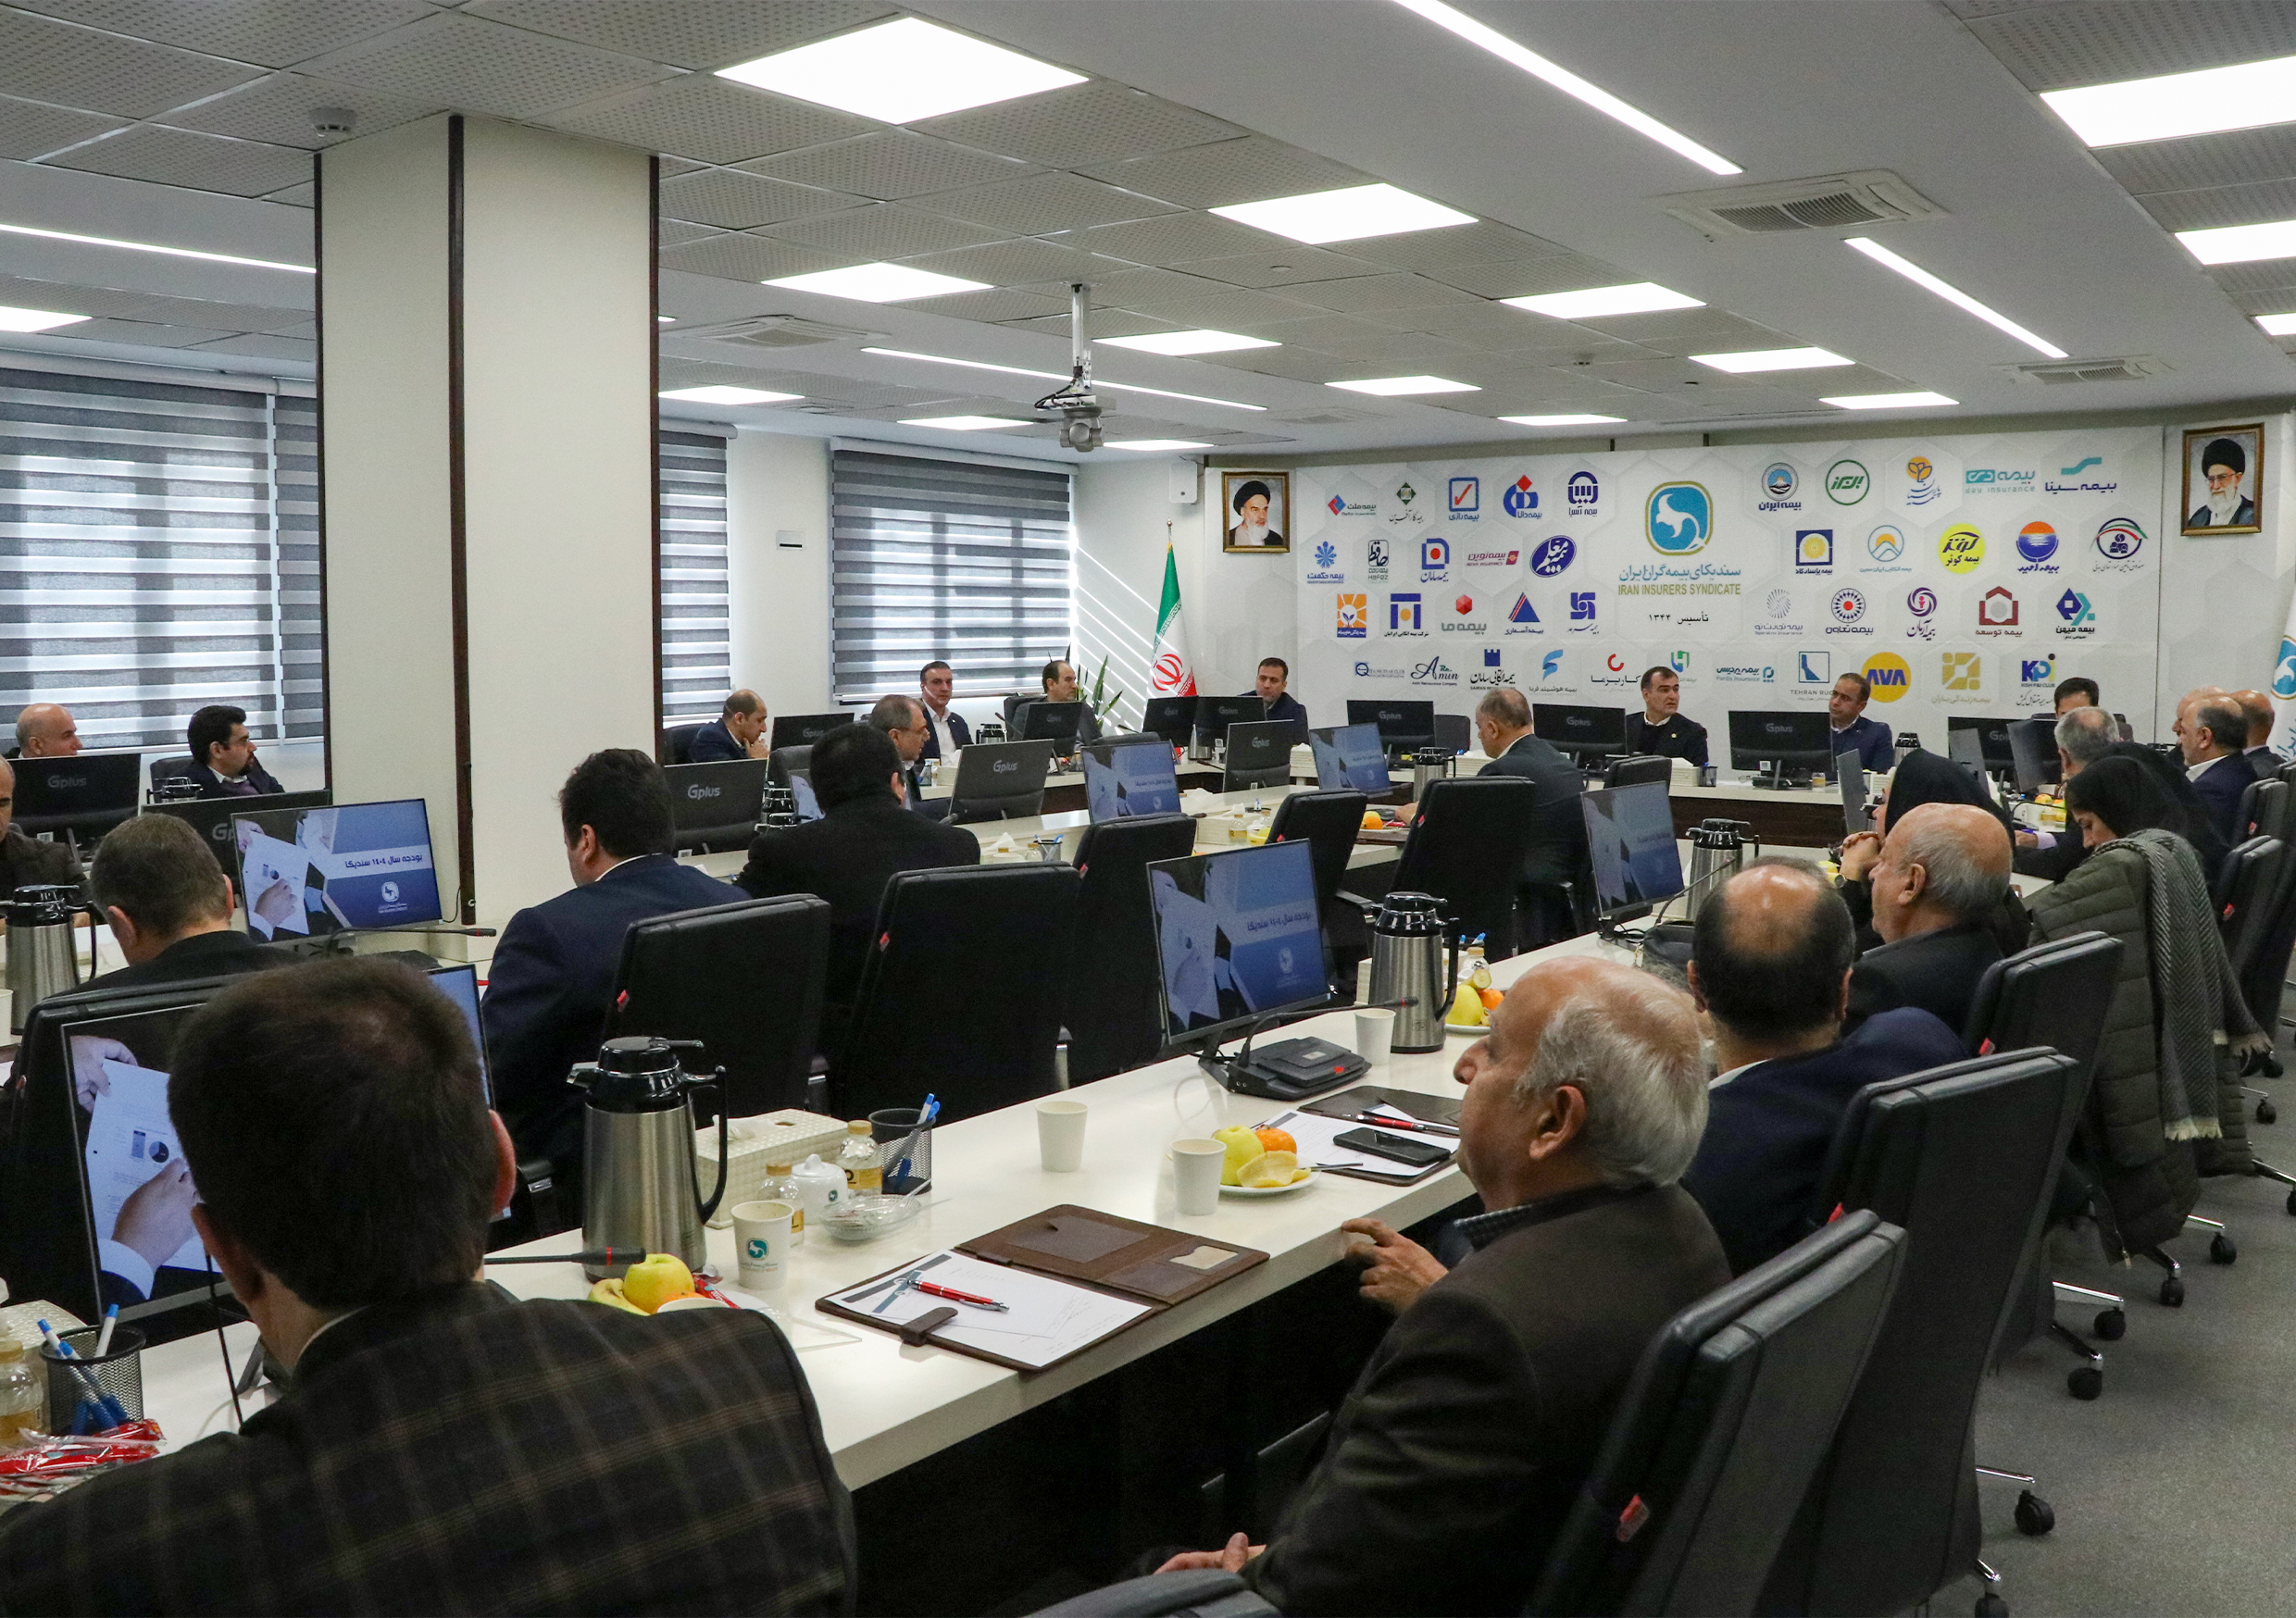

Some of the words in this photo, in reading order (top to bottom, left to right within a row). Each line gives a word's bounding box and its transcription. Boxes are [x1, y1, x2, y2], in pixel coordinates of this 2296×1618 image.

[1997, 470, 2036, 484] بیمه
[1987, 485, 2036, 493] insurance
[2045, 481, 2078, 495] سینا
[2080, 483, 2117, 493] بیمه
[1568, 505, 1583, 517] آسیا
[1758, 502, 1779, 512] ایران
[1780, 502, 1802, 511] بیمه
[1449, 512, 1464, 521] رازی
[1529, 512, 1542, 520] بیمه
[1584, 508, 1598, 517] بیمه
[1464, 514, 1479, 522] بیمه
[1467, 553, 1489, 562] نوین
[1488, 553, 1506, 561] بیمه
[1945, 554, 1963, 566] کوثر
[1965, 556, 1980, 565] بیمه
[1619, 565, 1646, 582] ایران
[1642, 563, 1666, 581] گران
[1665, 567, 1690, 581] بیمه
[1690, 563, 1741, 580] سندیکای
[1795, 567, 1821, 576] پاسارگاد
[1329, 573, 1344, 581] بیمه
[1420, 571, 1440, 583] سامان
[1618, 583, 1640, 595] IRAN
[1641, 583, 1687, 595] INSURERS
[1690, 583, 1741, 595] SYNDICATE
[1677, 611, 1709, 626] تأسیس
[1441, 622, 1455, 632] ما
[1456, 623, 1487, 636] بیمه
[1825, 624, 1851, 635] تعاون
[1851, 627, 1874, 636] بیمه
[1906, 618, 1933, 638] آرمان
[2055, 626, 2077, 635] میهن
[2078, 627, 2095, 635] بیمه
[1976, 629, 2002, 638] توسعه
[1716, 667, 1741, 676] پردیس
[1741, 667, 1760, 676] بیمه
[1470, 672, 1491, 684] سامان
[1591, 675, 1641, 687] کاریزما
[1866, 668, 1906, 686] AVA
[1379, 710, 1403, 720] Gplus
[1566, 716, 1591, 727] Gplus
[1766, 722, 1793, 734] Gplus
[1990, 730, 2008, 741] Gpl
[1253, 737, 1270, 749] Gplus
[993, 759, 1018, 774] Gplus
[47, 774, 87, 789] Gplus
[687, 783, 721, 801] Gplus
[387, 856, 401, 865] سال
[402, 854, 423, 864] بودجه
[345, 860, 370, 870] سندیکا
